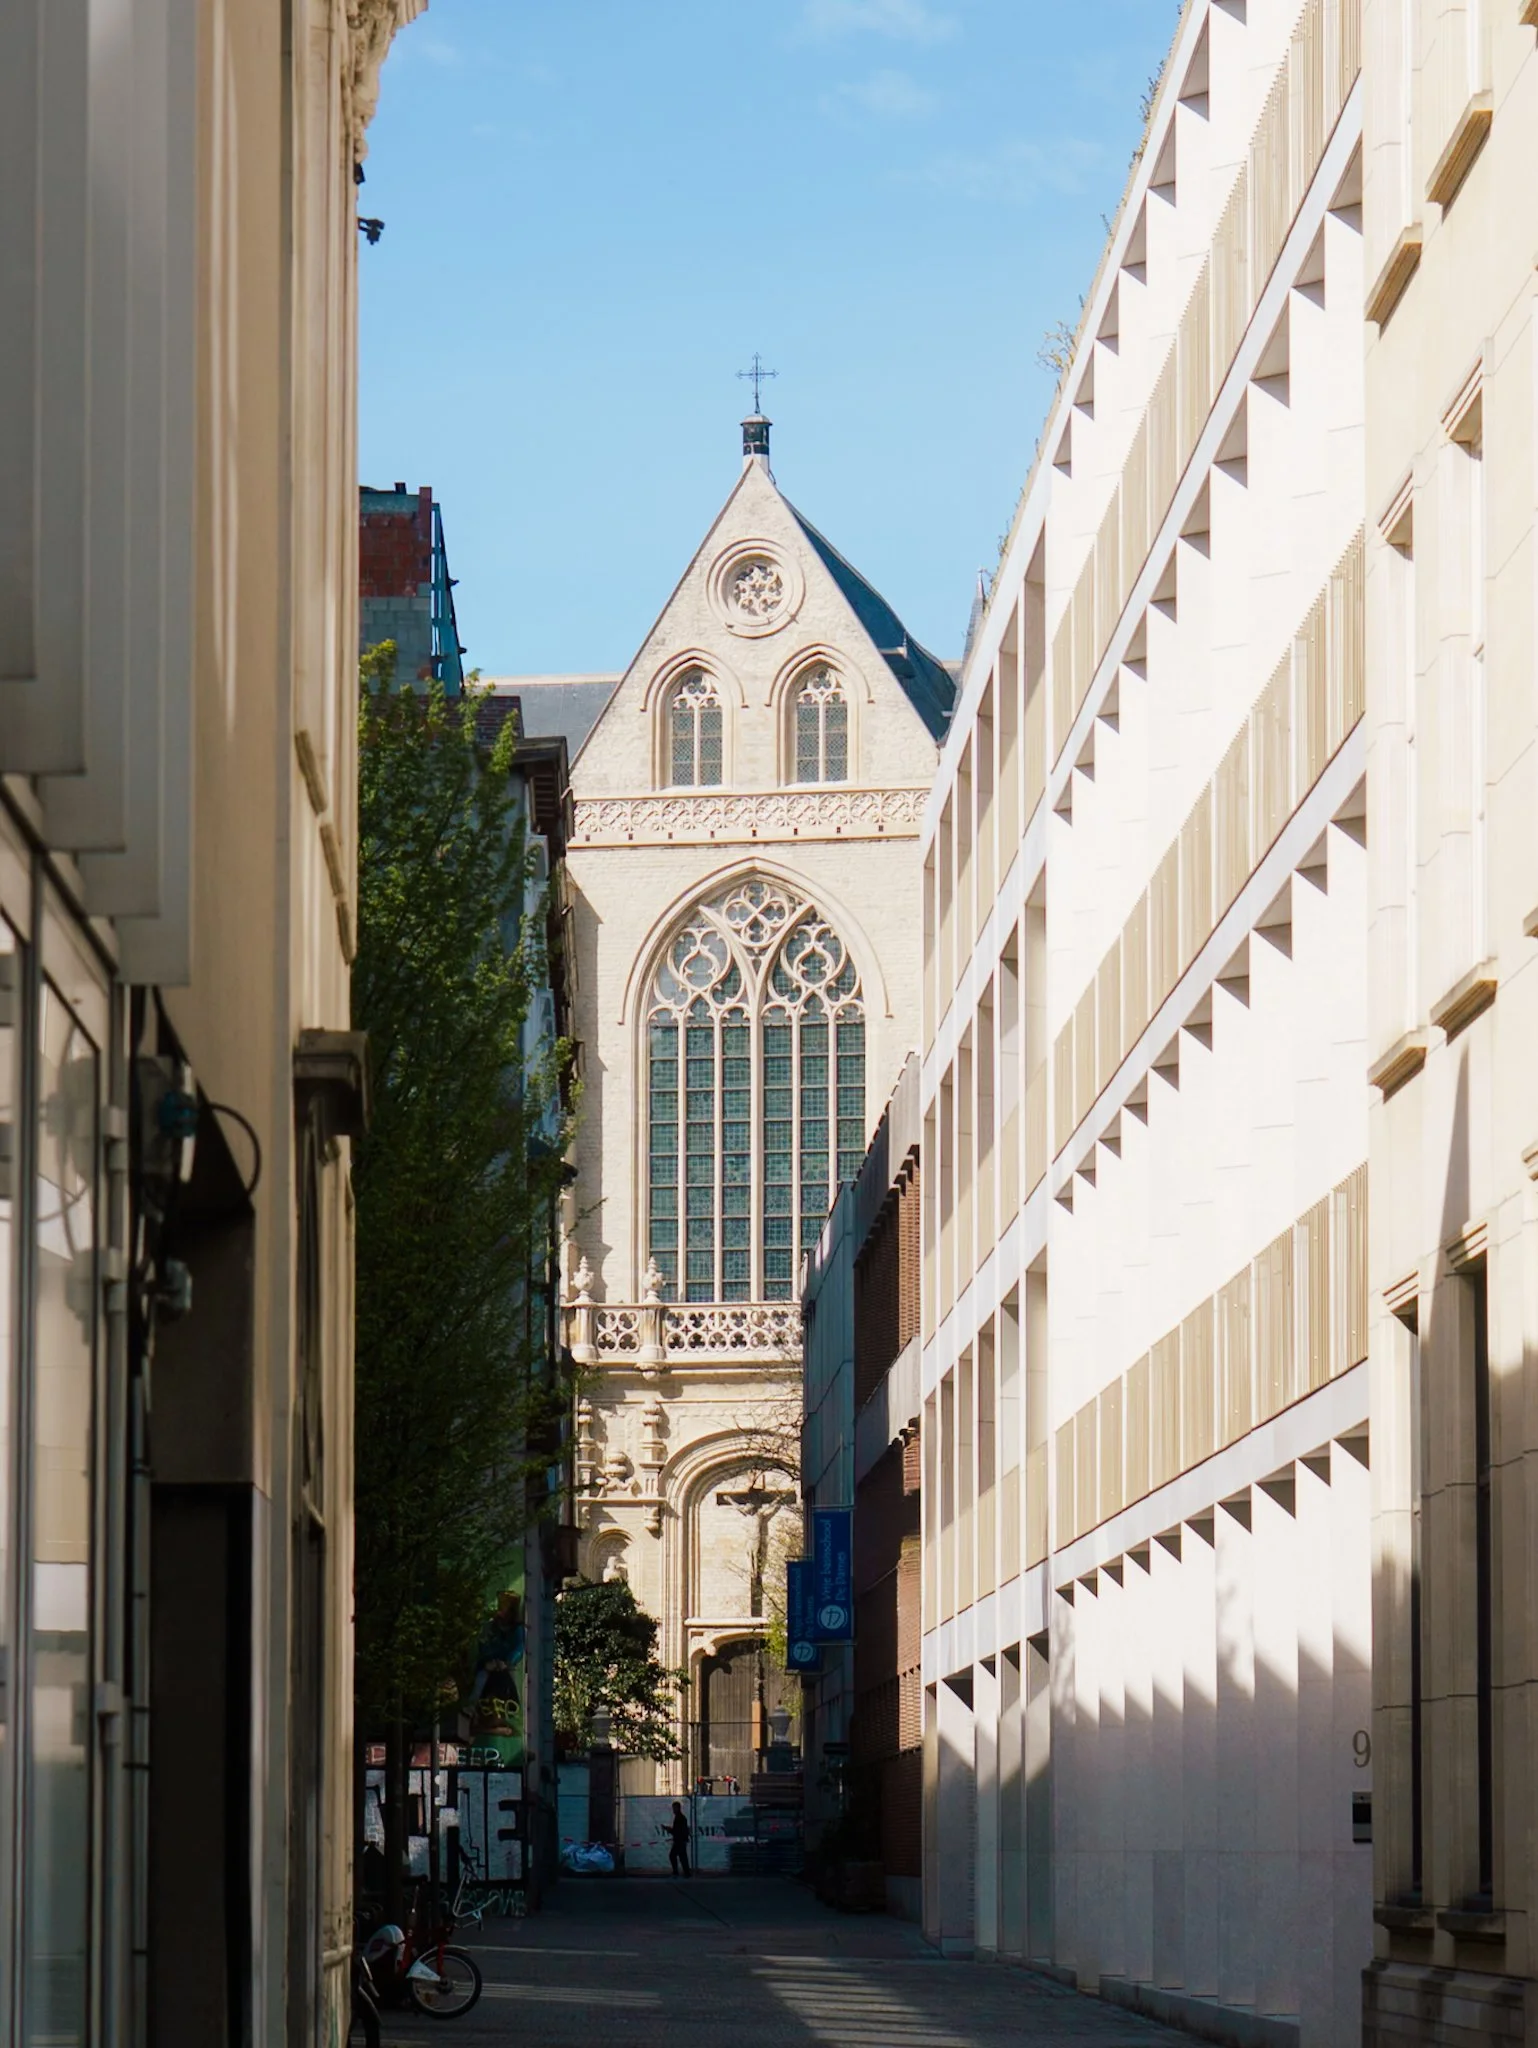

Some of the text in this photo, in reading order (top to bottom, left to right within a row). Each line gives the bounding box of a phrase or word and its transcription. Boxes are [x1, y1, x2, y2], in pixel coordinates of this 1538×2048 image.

[819, 1519, 833, 1602] Vrije basisschool
[835, 1552, 846, 1601] De Dames
[1352, 1730, 1371, 1768] 9
